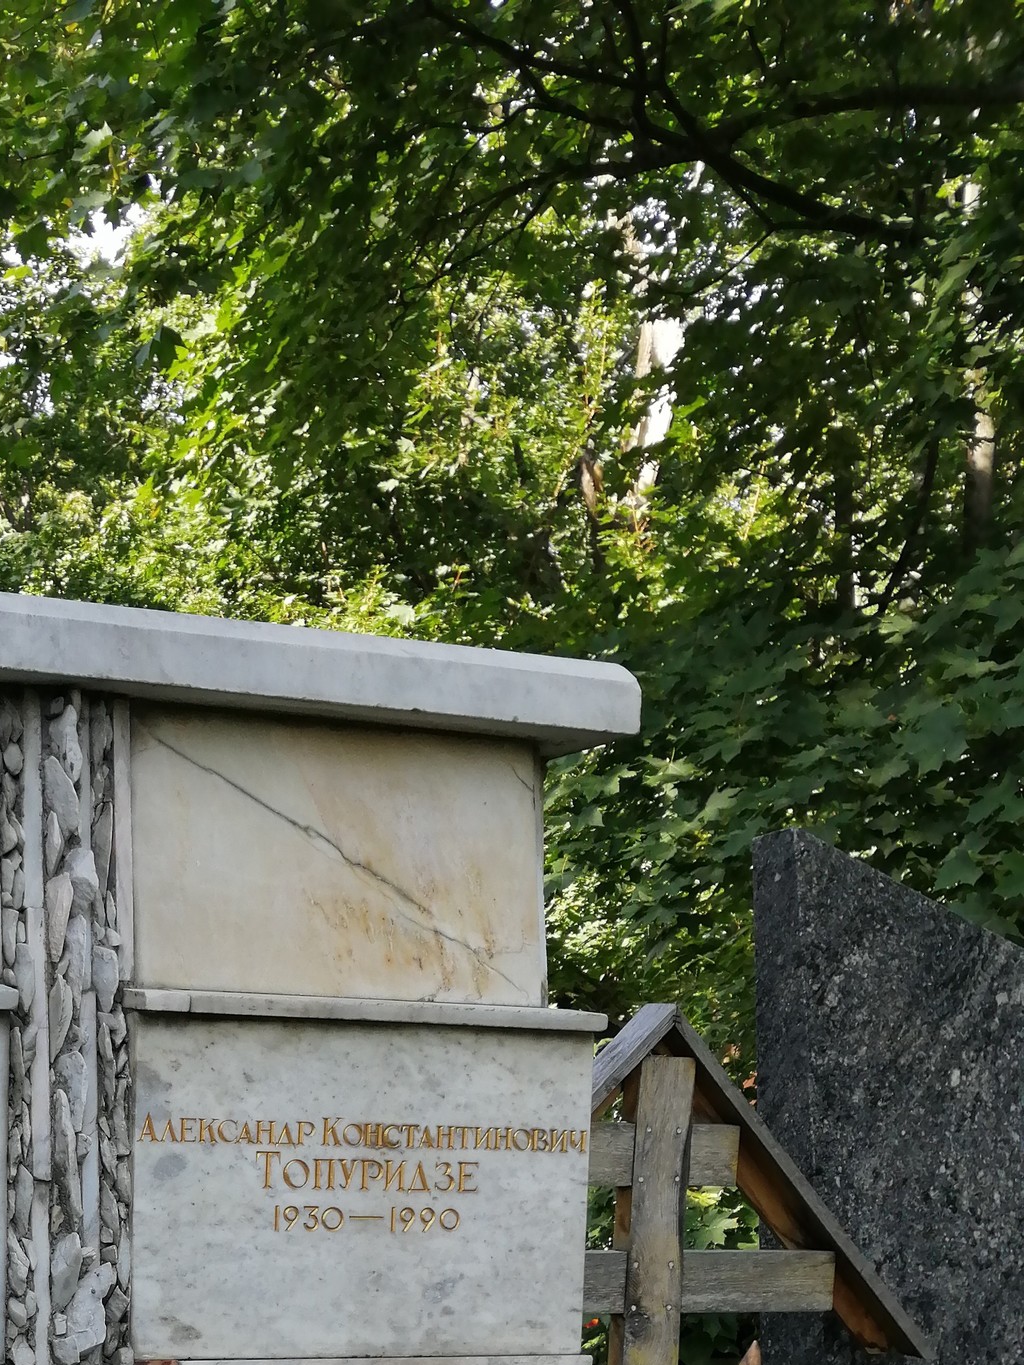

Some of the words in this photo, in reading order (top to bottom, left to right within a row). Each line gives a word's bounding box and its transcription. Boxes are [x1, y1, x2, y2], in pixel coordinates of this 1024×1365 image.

[137, 1111, 317, 1147] АЛЕКСАНДР
[321, 1117, 588, 1155] КОНСТАНТИНОВИЧ
[256, 1151, 480, 1193] ТОПУРИДЗЕ
